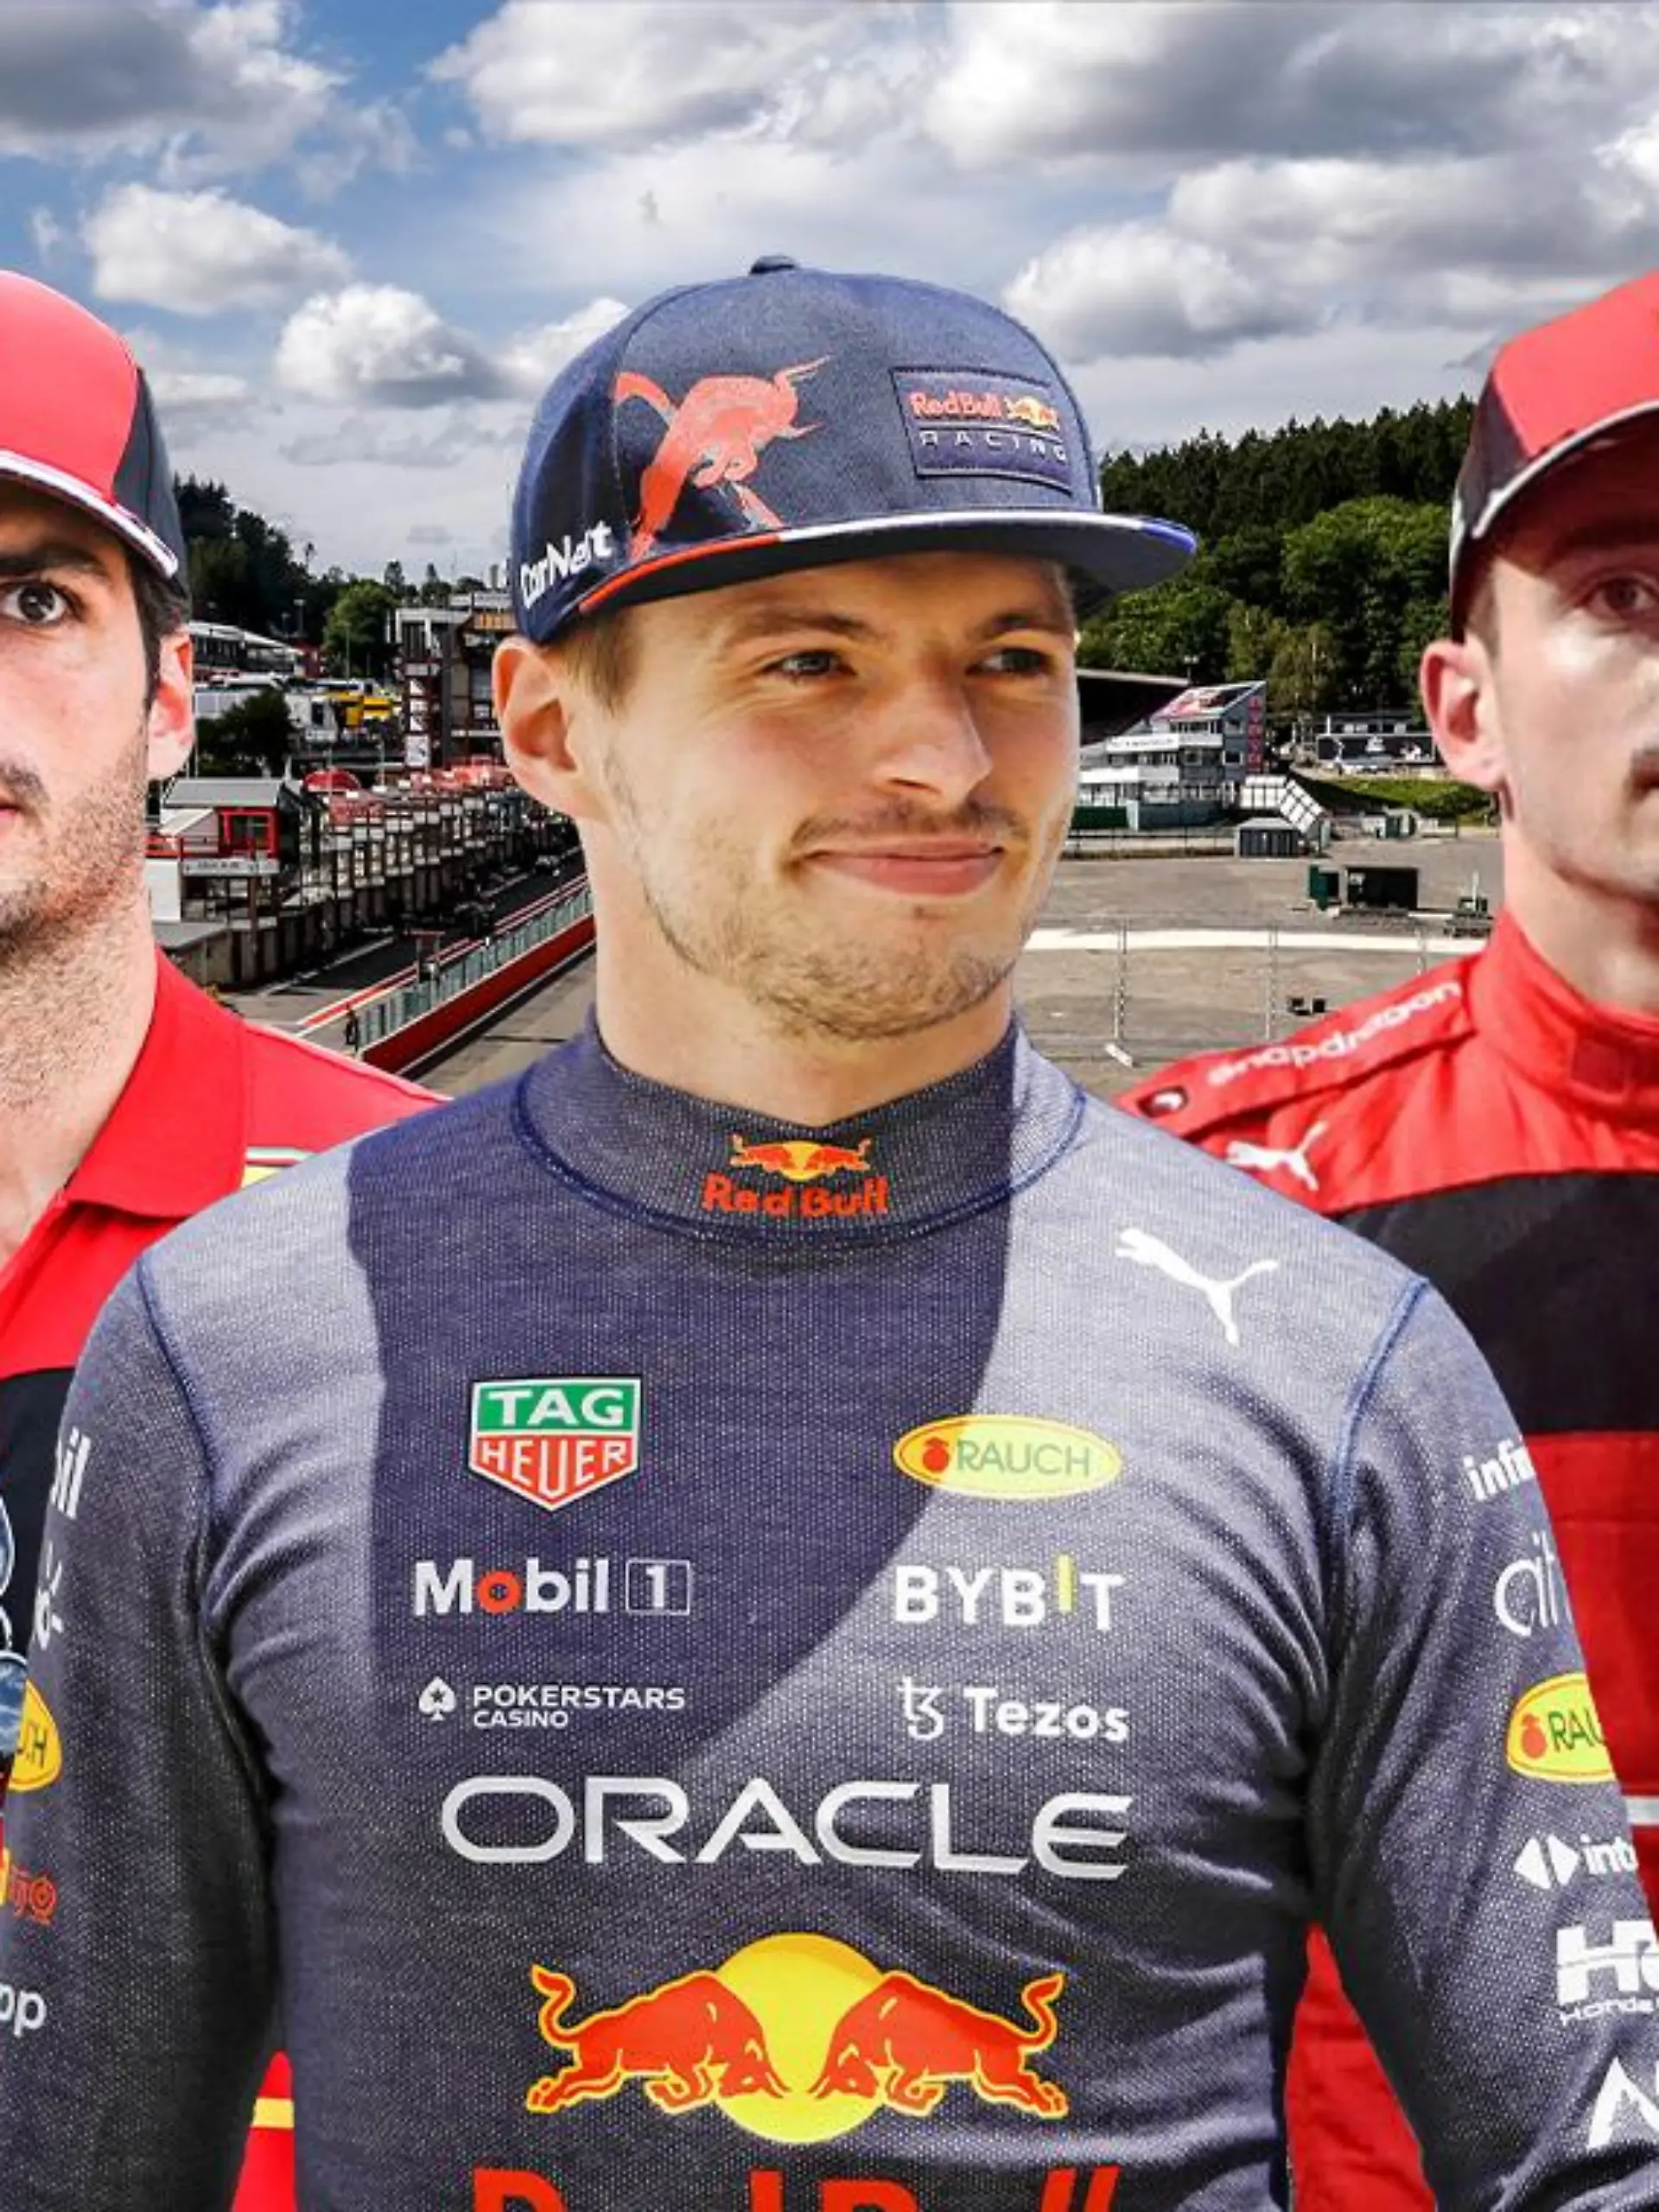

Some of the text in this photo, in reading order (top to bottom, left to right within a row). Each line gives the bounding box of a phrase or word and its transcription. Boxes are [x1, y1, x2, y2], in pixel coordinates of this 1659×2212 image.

[920, 432, 1067, 461] RACING
[489, 1389, 624, 1427] TAG
[481, 1440, 627, 1498] HEUER
[957, 1439, 1090, 1476] RAUCH
[415, 1559, 666, 1616] Mobil 1
[895, 1554, 1126, 1631] BYBIT
[472, 1684, 685, 1710] POKERSTARS
[473, 1710, 569, 1728] CASINO
[964, 1687, 1129, 1743] Tezos
[441, 1776, 1133, 1879] ORACLE
